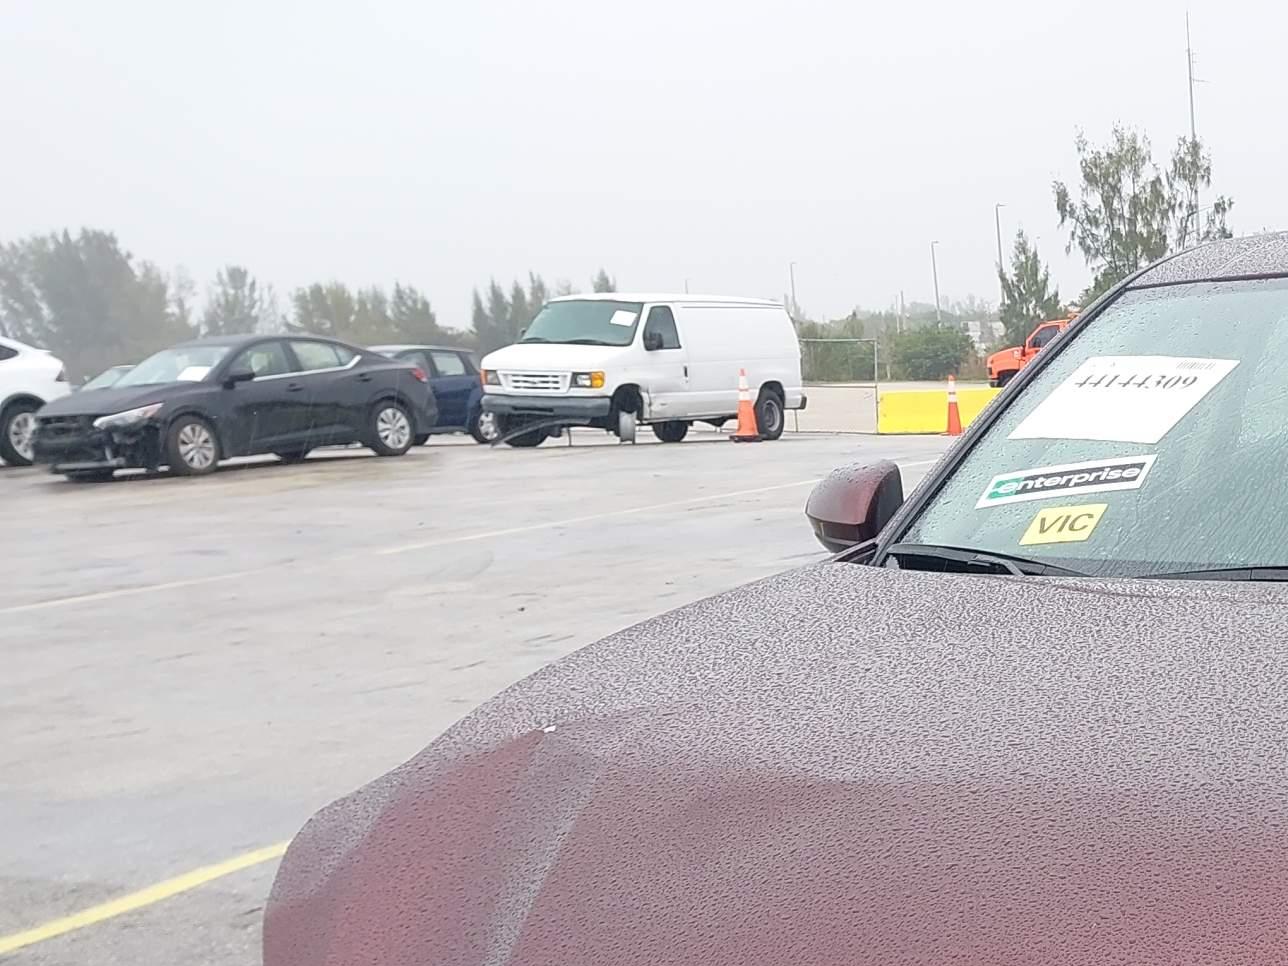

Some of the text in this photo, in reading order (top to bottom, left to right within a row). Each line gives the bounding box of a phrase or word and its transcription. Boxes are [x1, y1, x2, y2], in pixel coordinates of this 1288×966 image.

[1075, 374, 1198, 390] 44144309
[998, 467, 1141, 494] enterprise
[1038, 512, 1095, 535] VIC
